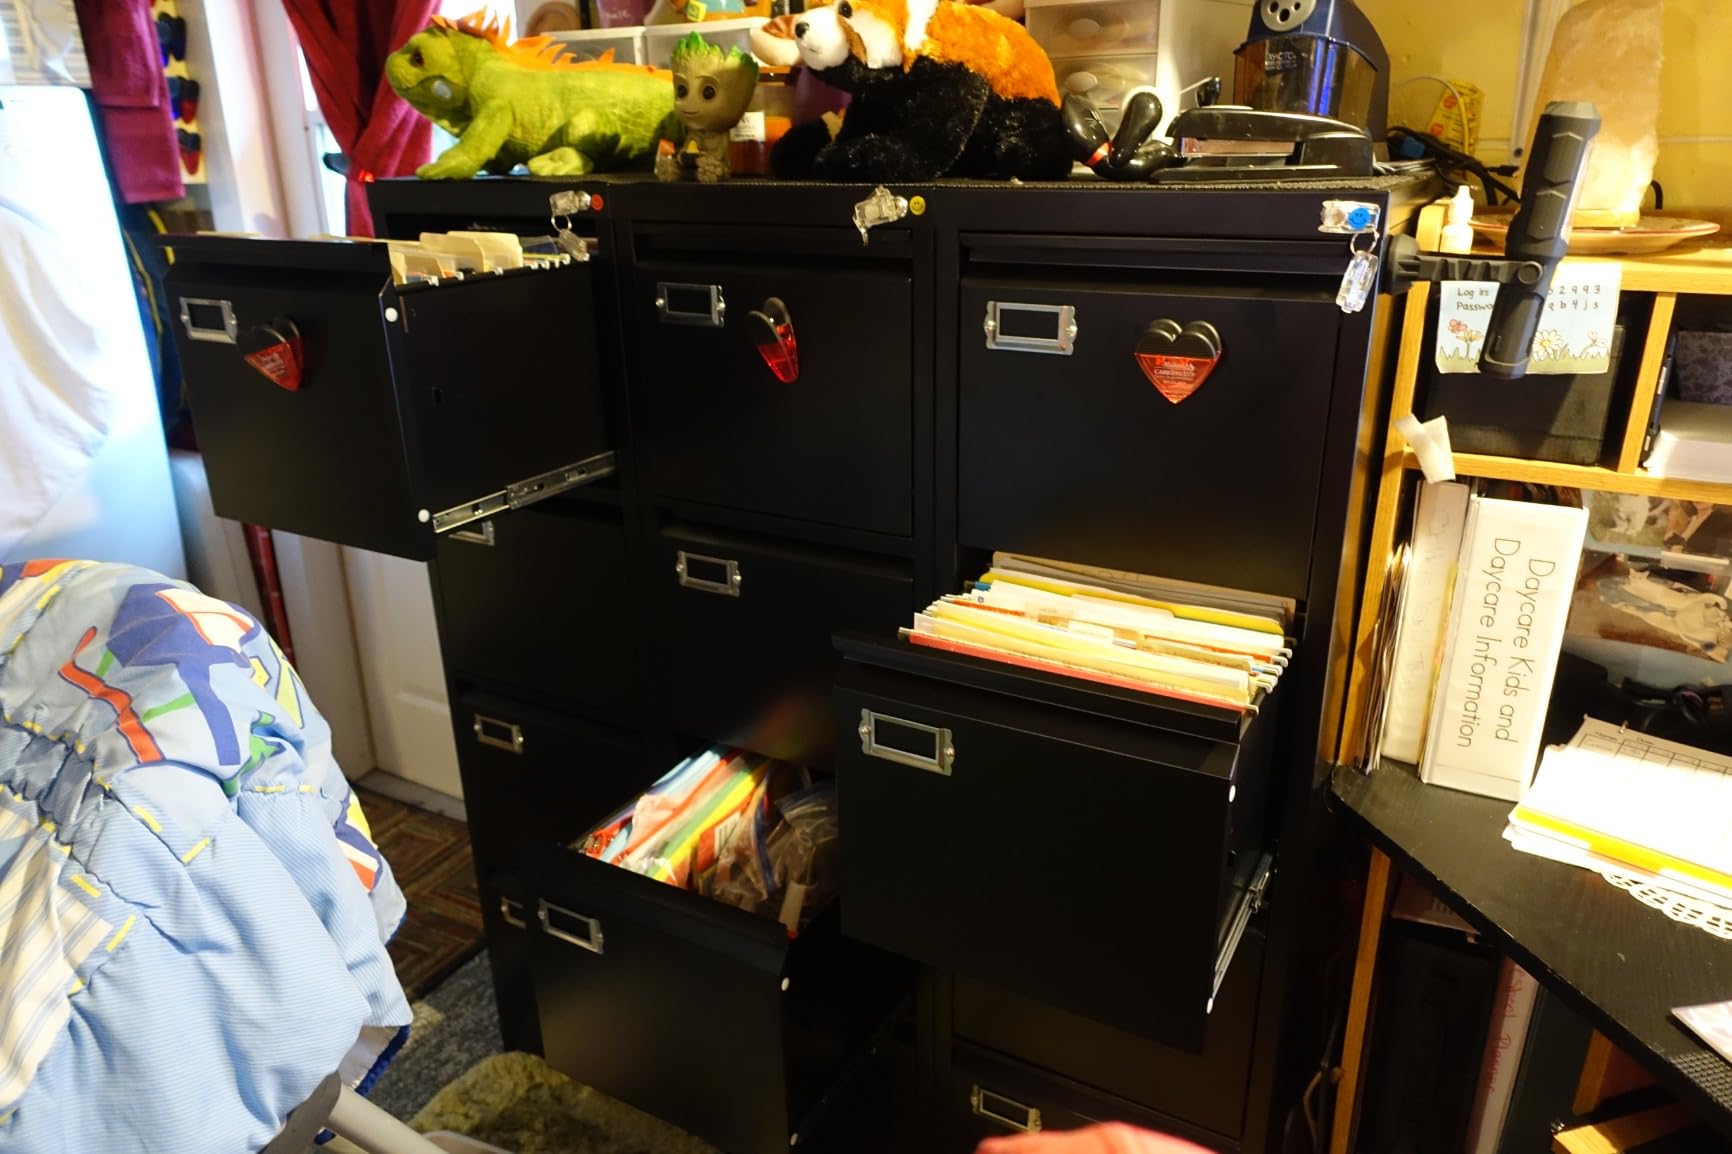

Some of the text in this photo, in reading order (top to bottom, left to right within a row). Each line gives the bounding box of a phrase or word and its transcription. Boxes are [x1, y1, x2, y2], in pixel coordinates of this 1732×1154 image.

[1456, 301, 1495, 312] Passwo
[1457, 287, 1475, 299] Log
[1457, 537, 1521, 748] Daycare Information
[1494, 558, 1556, 742] Daycare Kids and
